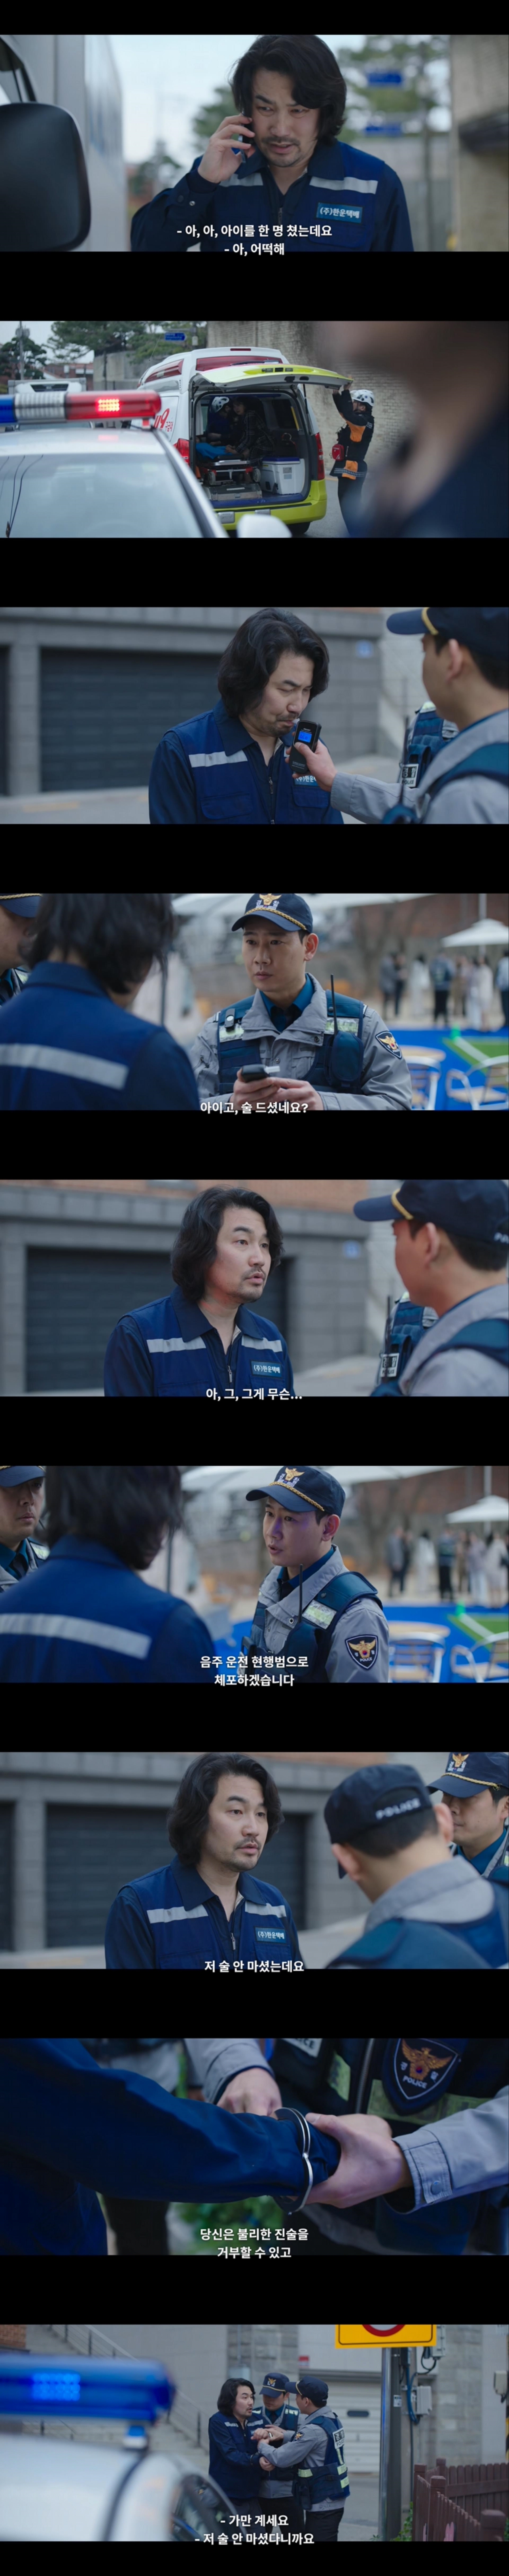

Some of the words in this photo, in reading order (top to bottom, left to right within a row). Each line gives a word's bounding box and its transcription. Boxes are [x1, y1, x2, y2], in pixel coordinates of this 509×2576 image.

[320, 207, 360, 218] (주)한운택배
[153, 408, 170, 429] 119
[375, 1798, 421, 1820] POLICE
[402, 2075, 427, 2089] POLICE
